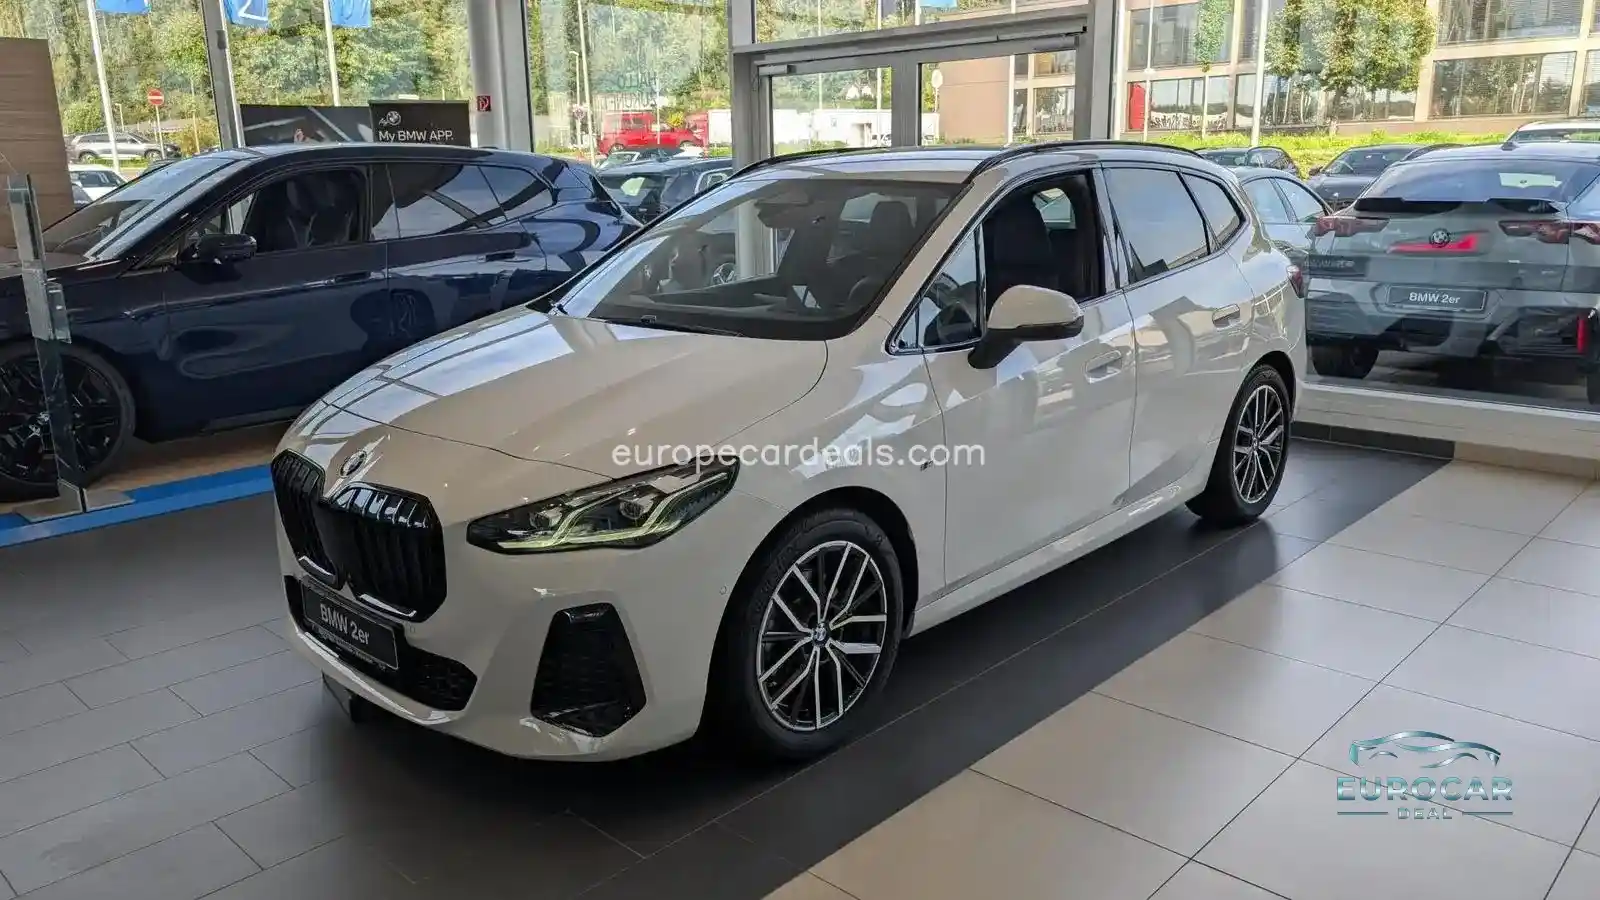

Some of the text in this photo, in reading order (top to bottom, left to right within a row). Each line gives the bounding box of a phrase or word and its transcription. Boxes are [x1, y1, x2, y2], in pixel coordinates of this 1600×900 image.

[379, 131, 395, 143] My
[398, 130, 426, 141] BMW
[1409, 291, 1461, 304] BMW 2er
[320, 603, 370, 645] BMW 2er
